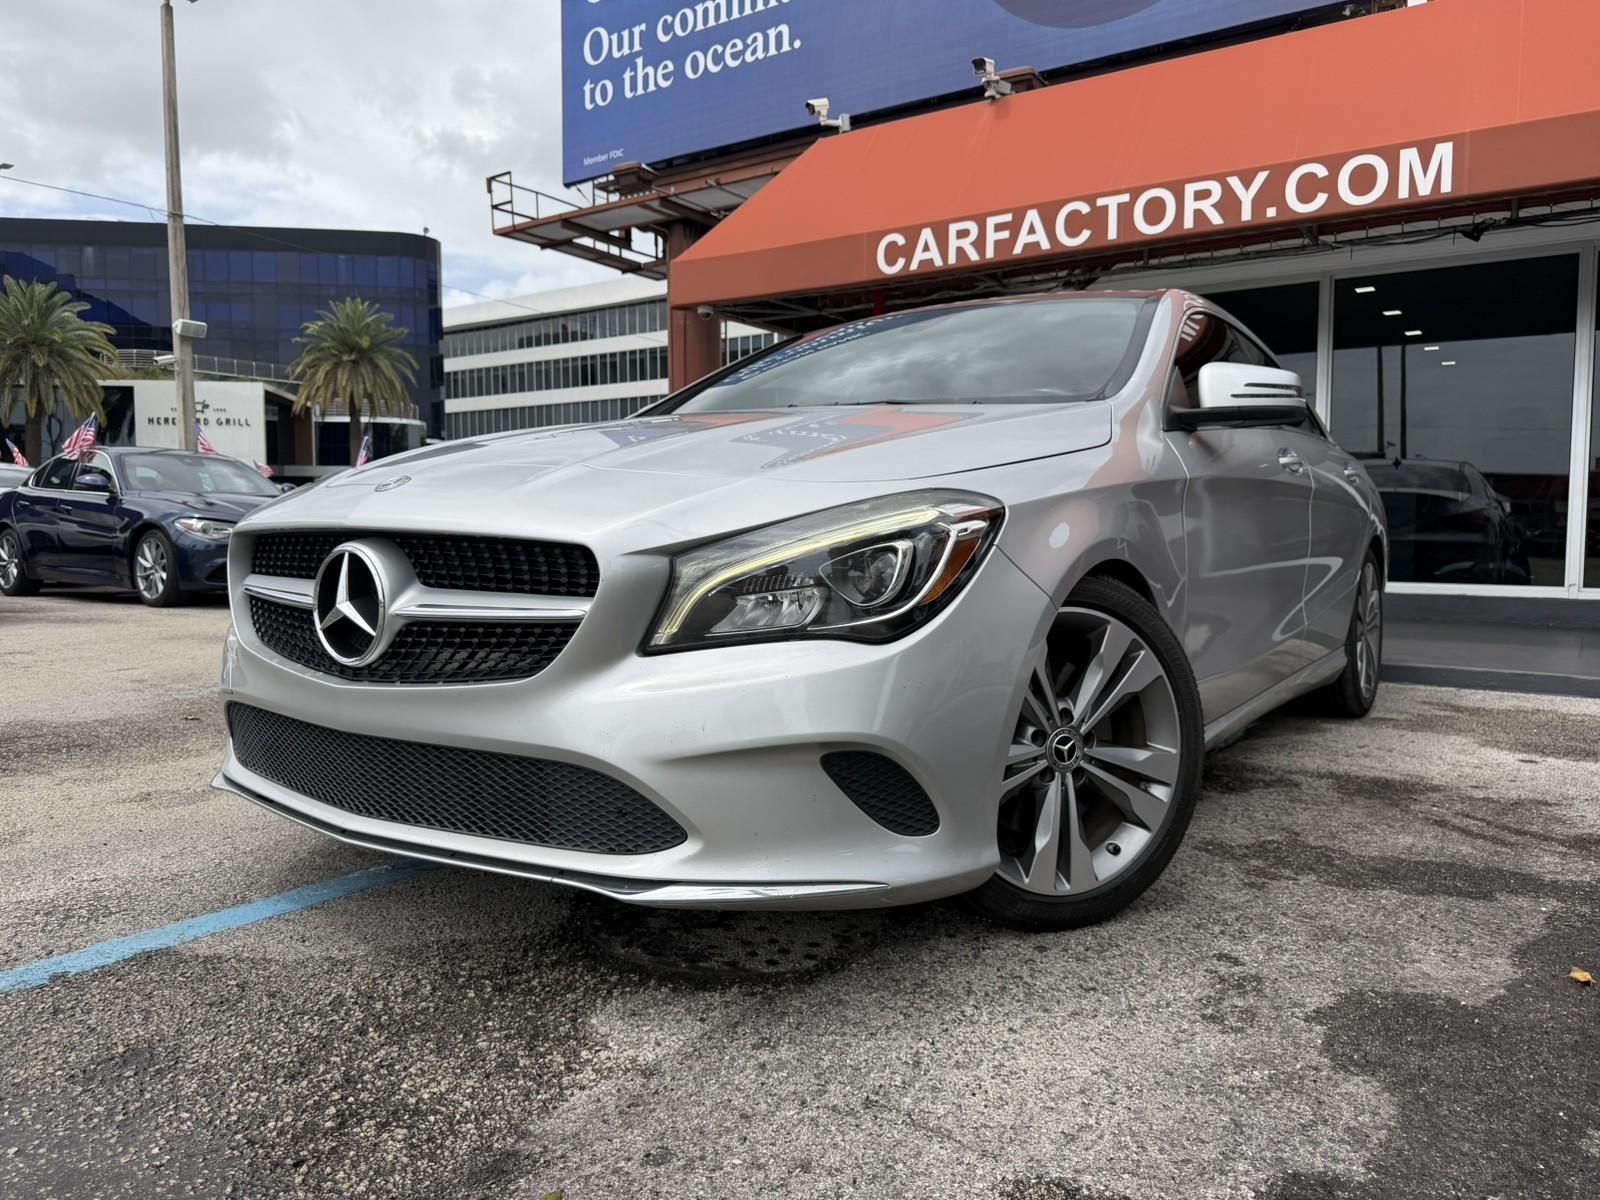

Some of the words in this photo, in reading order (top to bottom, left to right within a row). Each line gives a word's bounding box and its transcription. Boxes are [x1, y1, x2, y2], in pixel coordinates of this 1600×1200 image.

[583, 22, 647, 66] Our
[582, 78, 614, 111] to
[622, 55, 675, 99] the
[684, 23, 802, 80] ocean.
[583, 153, 609, 166] Member
[609, 147, 625, 160] FDIC
[876, 140, 1454, 276] CARFACTORY.COM
[147, 416, 210, 427] HERERD
[216, 417, 251, 428] GRILL
